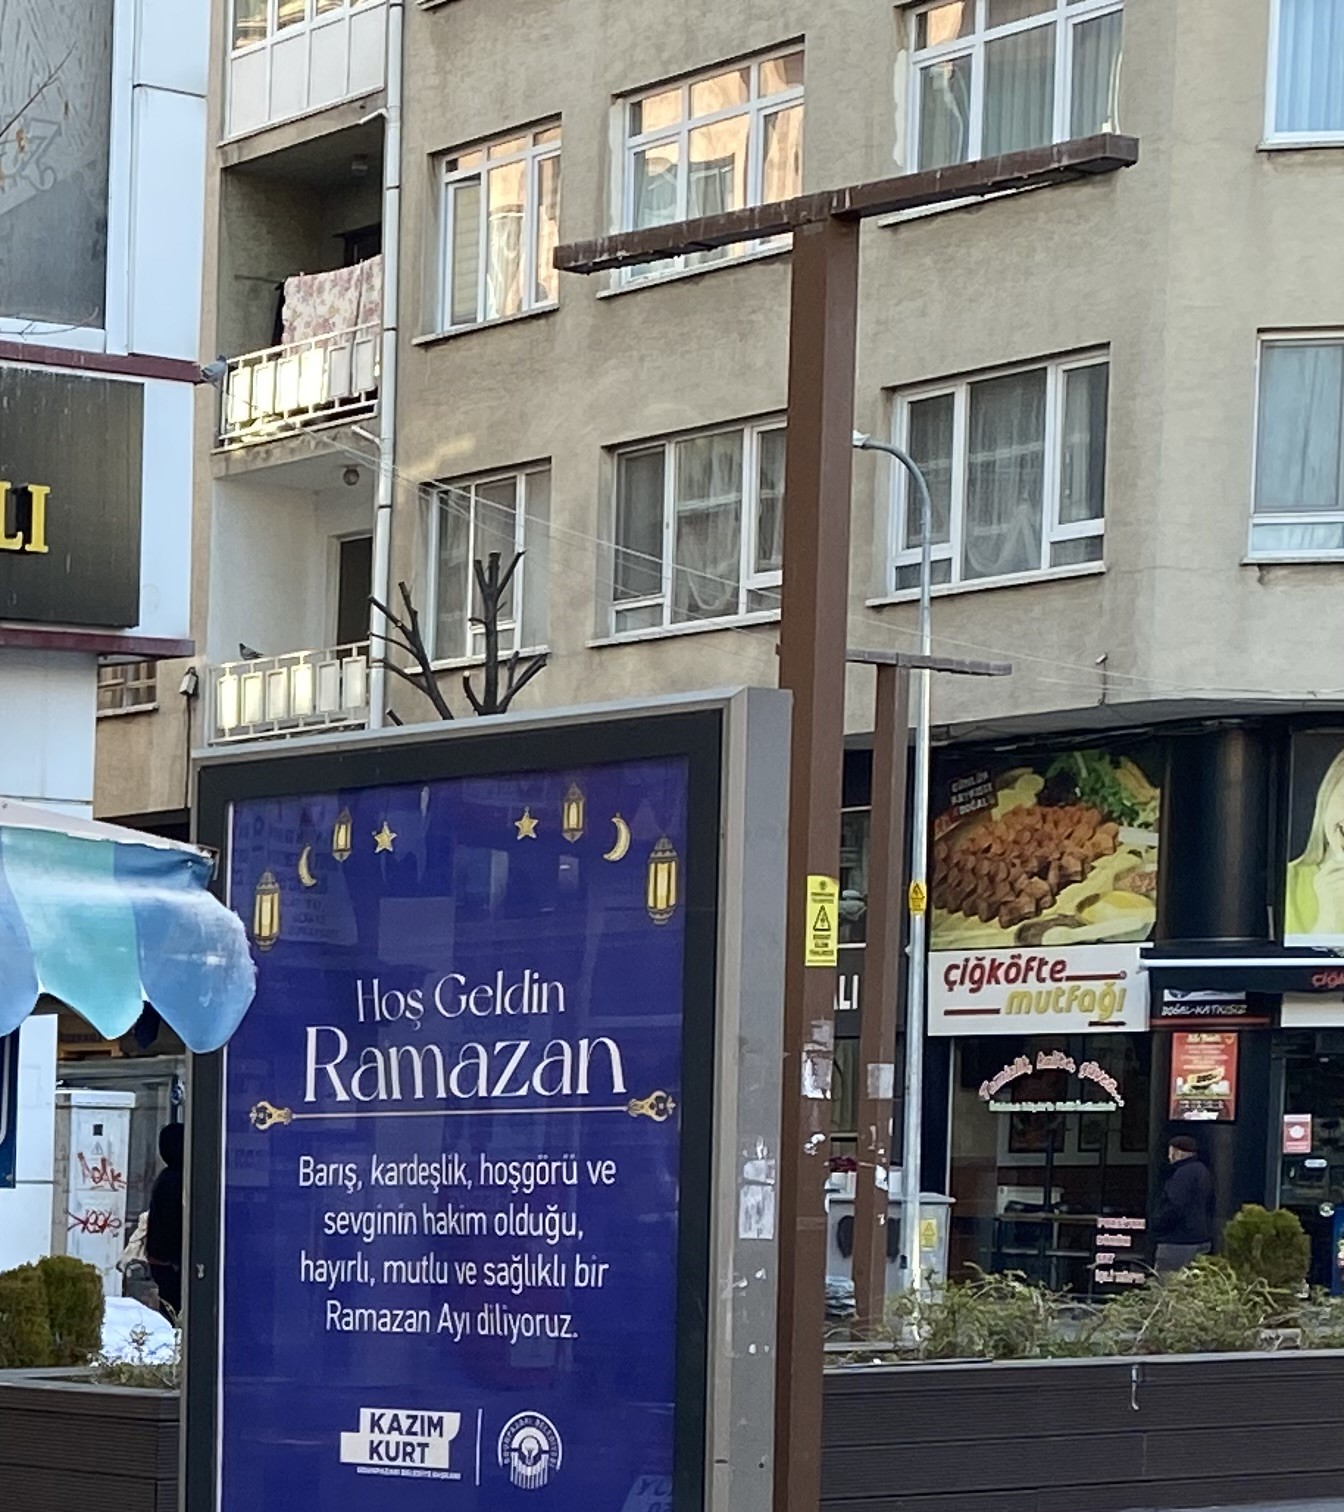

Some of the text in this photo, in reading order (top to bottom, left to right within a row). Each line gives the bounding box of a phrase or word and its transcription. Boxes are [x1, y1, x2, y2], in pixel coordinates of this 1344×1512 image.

[833, 974, 860, 1010] LI
[944, 953, 1067, 994] çiğköfte
[356, 969, 567, 1031] Hoş Geldin
[1005, 981, 1128, 1022] mutfağı
[304, 1025, 627, 1102] Ramazan
[299, 1153, 617, 1194] Barış, kardeşlik, hoşgörü ve
[323, 1203, 584, 1245] sevginin hakim olduğu,
[300, 1250, 610, 1295] hayırlı, mutlu ve sağlıklı bir
[326, 1300, 579, 1345] Ramazan Ayı diliyoruz.
[370, 1412, 444, 1437] KAZIM
[368, 1440, 430, 1464] KURT
